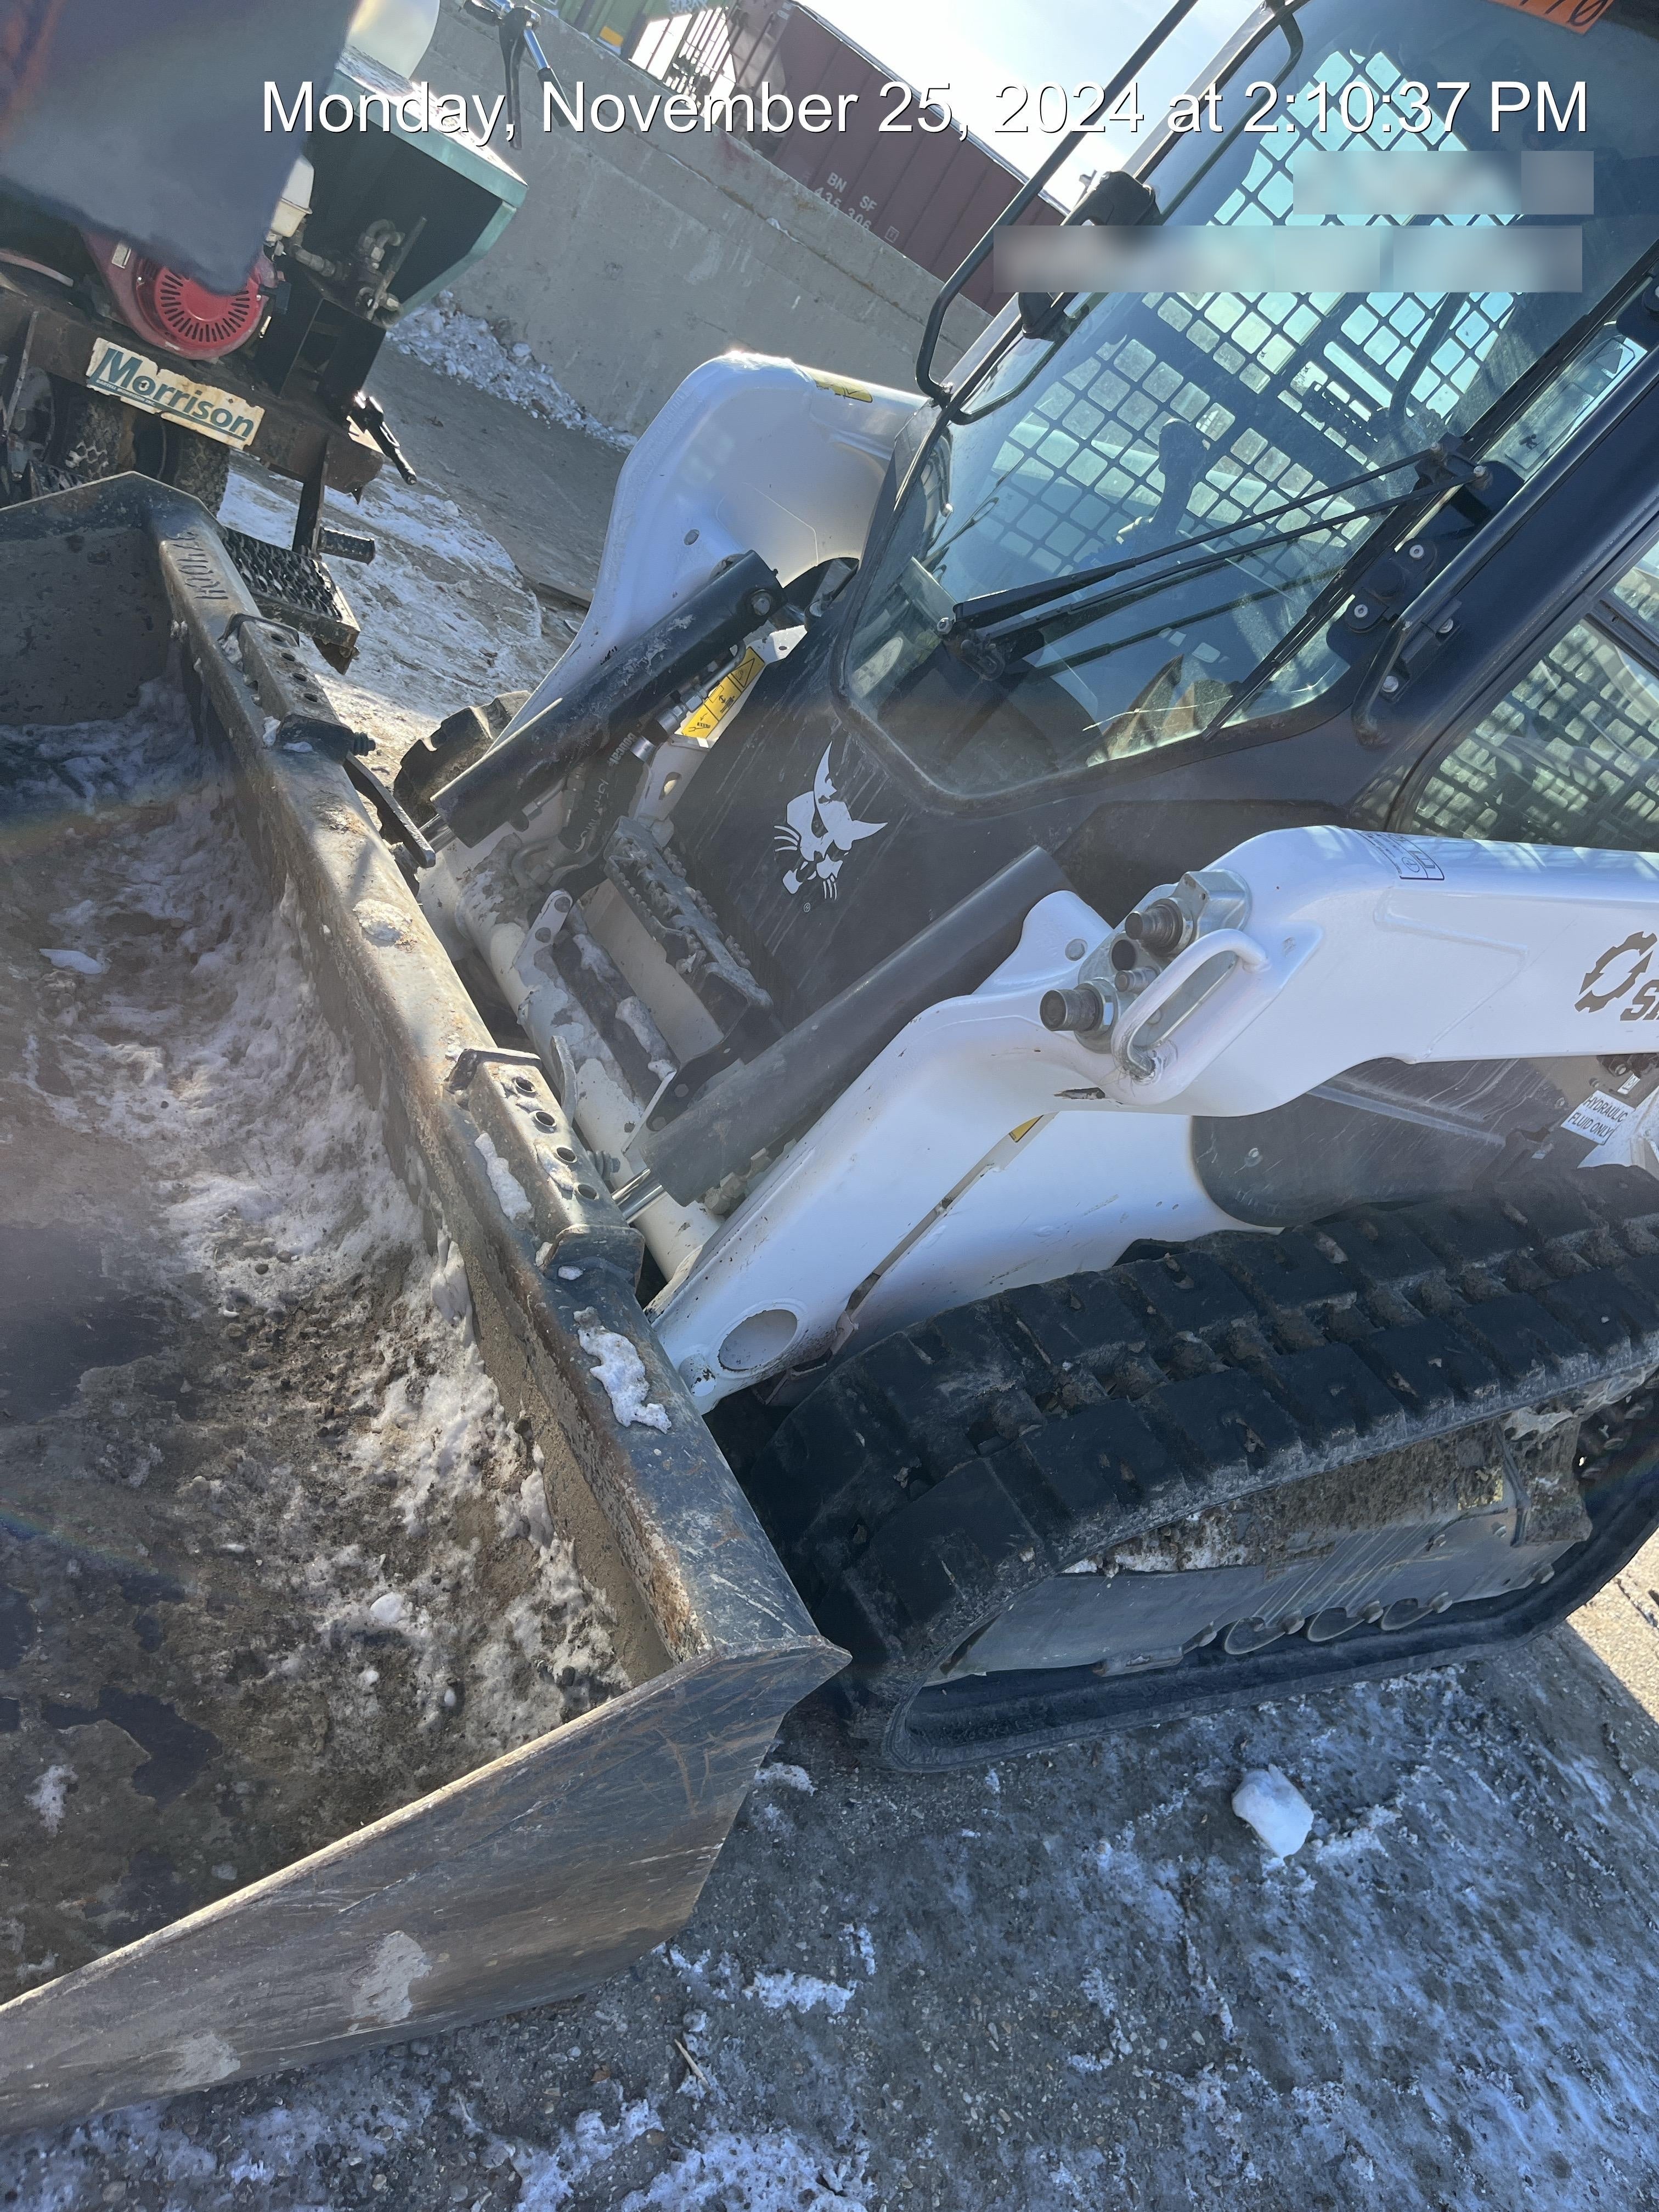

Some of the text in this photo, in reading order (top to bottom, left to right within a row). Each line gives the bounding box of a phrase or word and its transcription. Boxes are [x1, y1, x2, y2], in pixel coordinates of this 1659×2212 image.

[89, 348, 255, 437] Morrison
[1583, 1095, 1628, 1122] HYDRAULIC
[1567, 1112, 1615, 1138] FLUID ONLY
